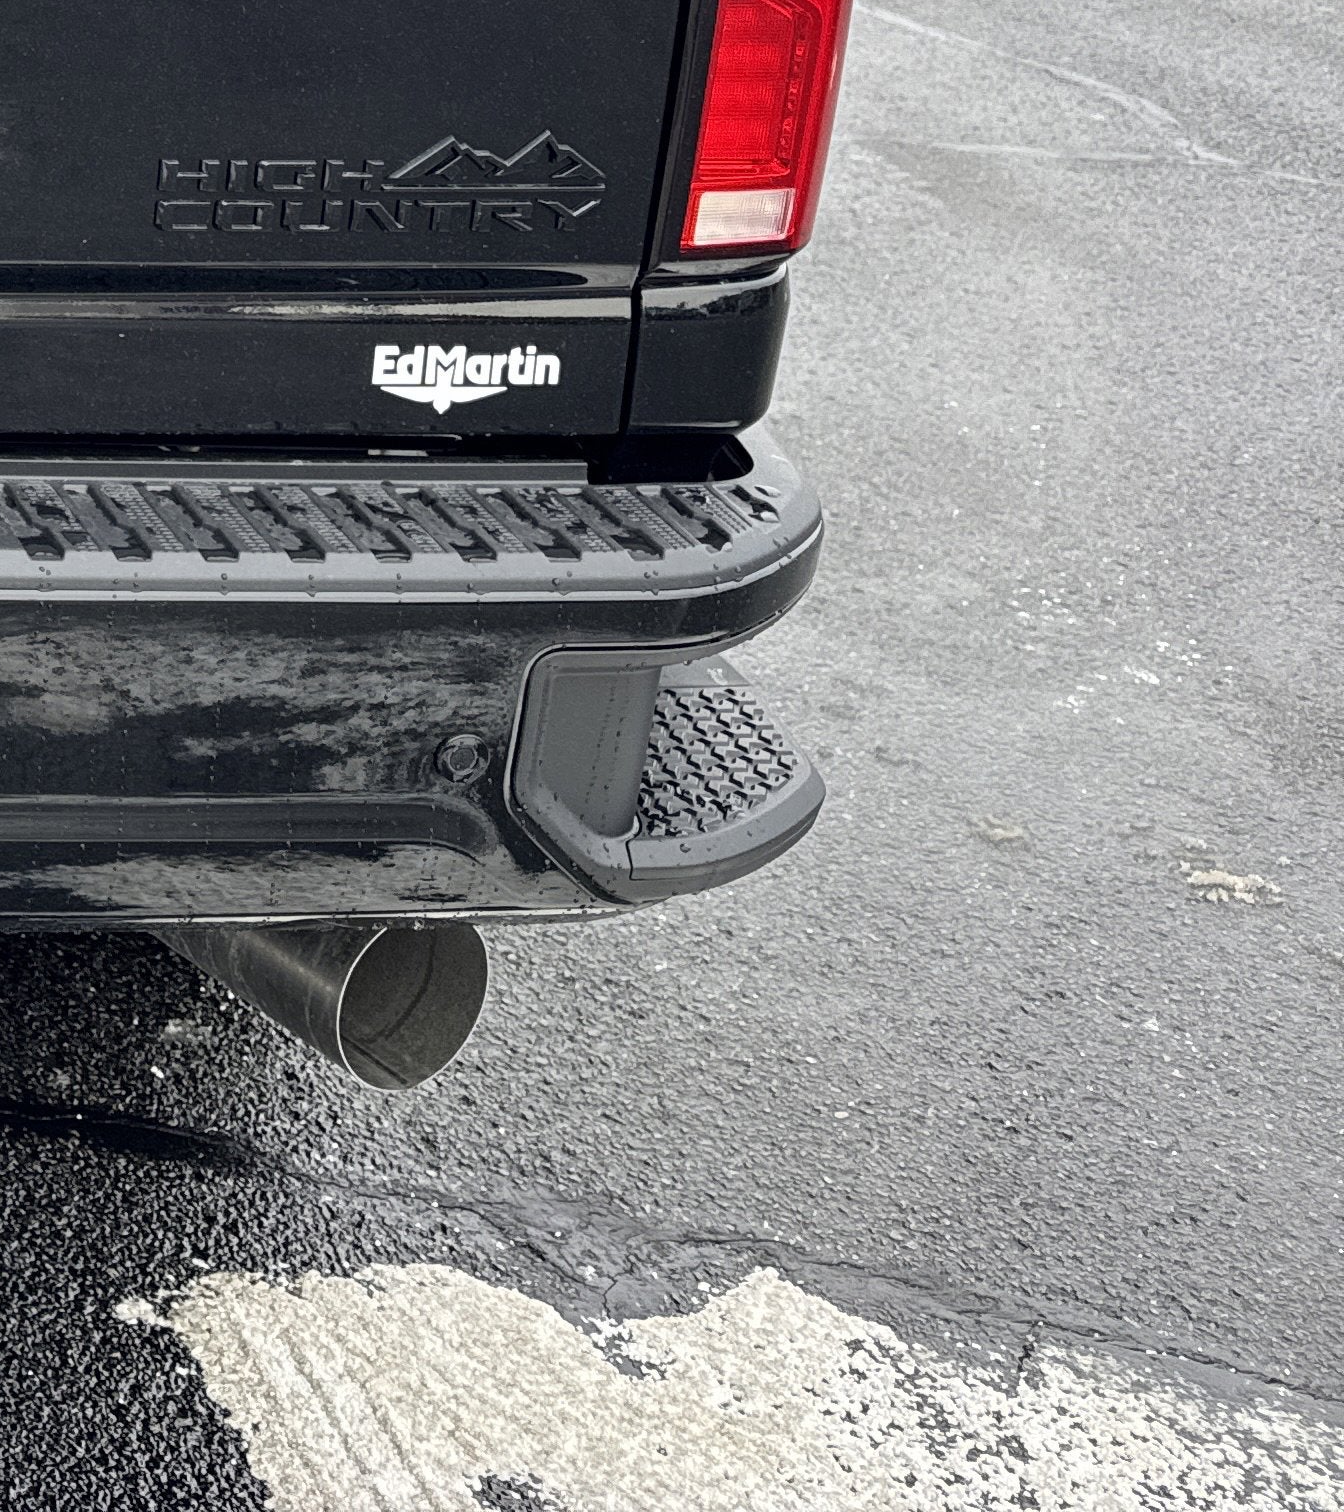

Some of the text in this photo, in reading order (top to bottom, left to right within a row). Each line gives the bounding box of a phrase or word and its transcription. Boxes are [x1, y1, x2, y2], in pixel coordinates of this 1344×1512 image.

[157, 159, 385, 192] HIGH
[154, 198, 601, 233] COUNTRY
[371, 345, 561, 386] EdMartin
